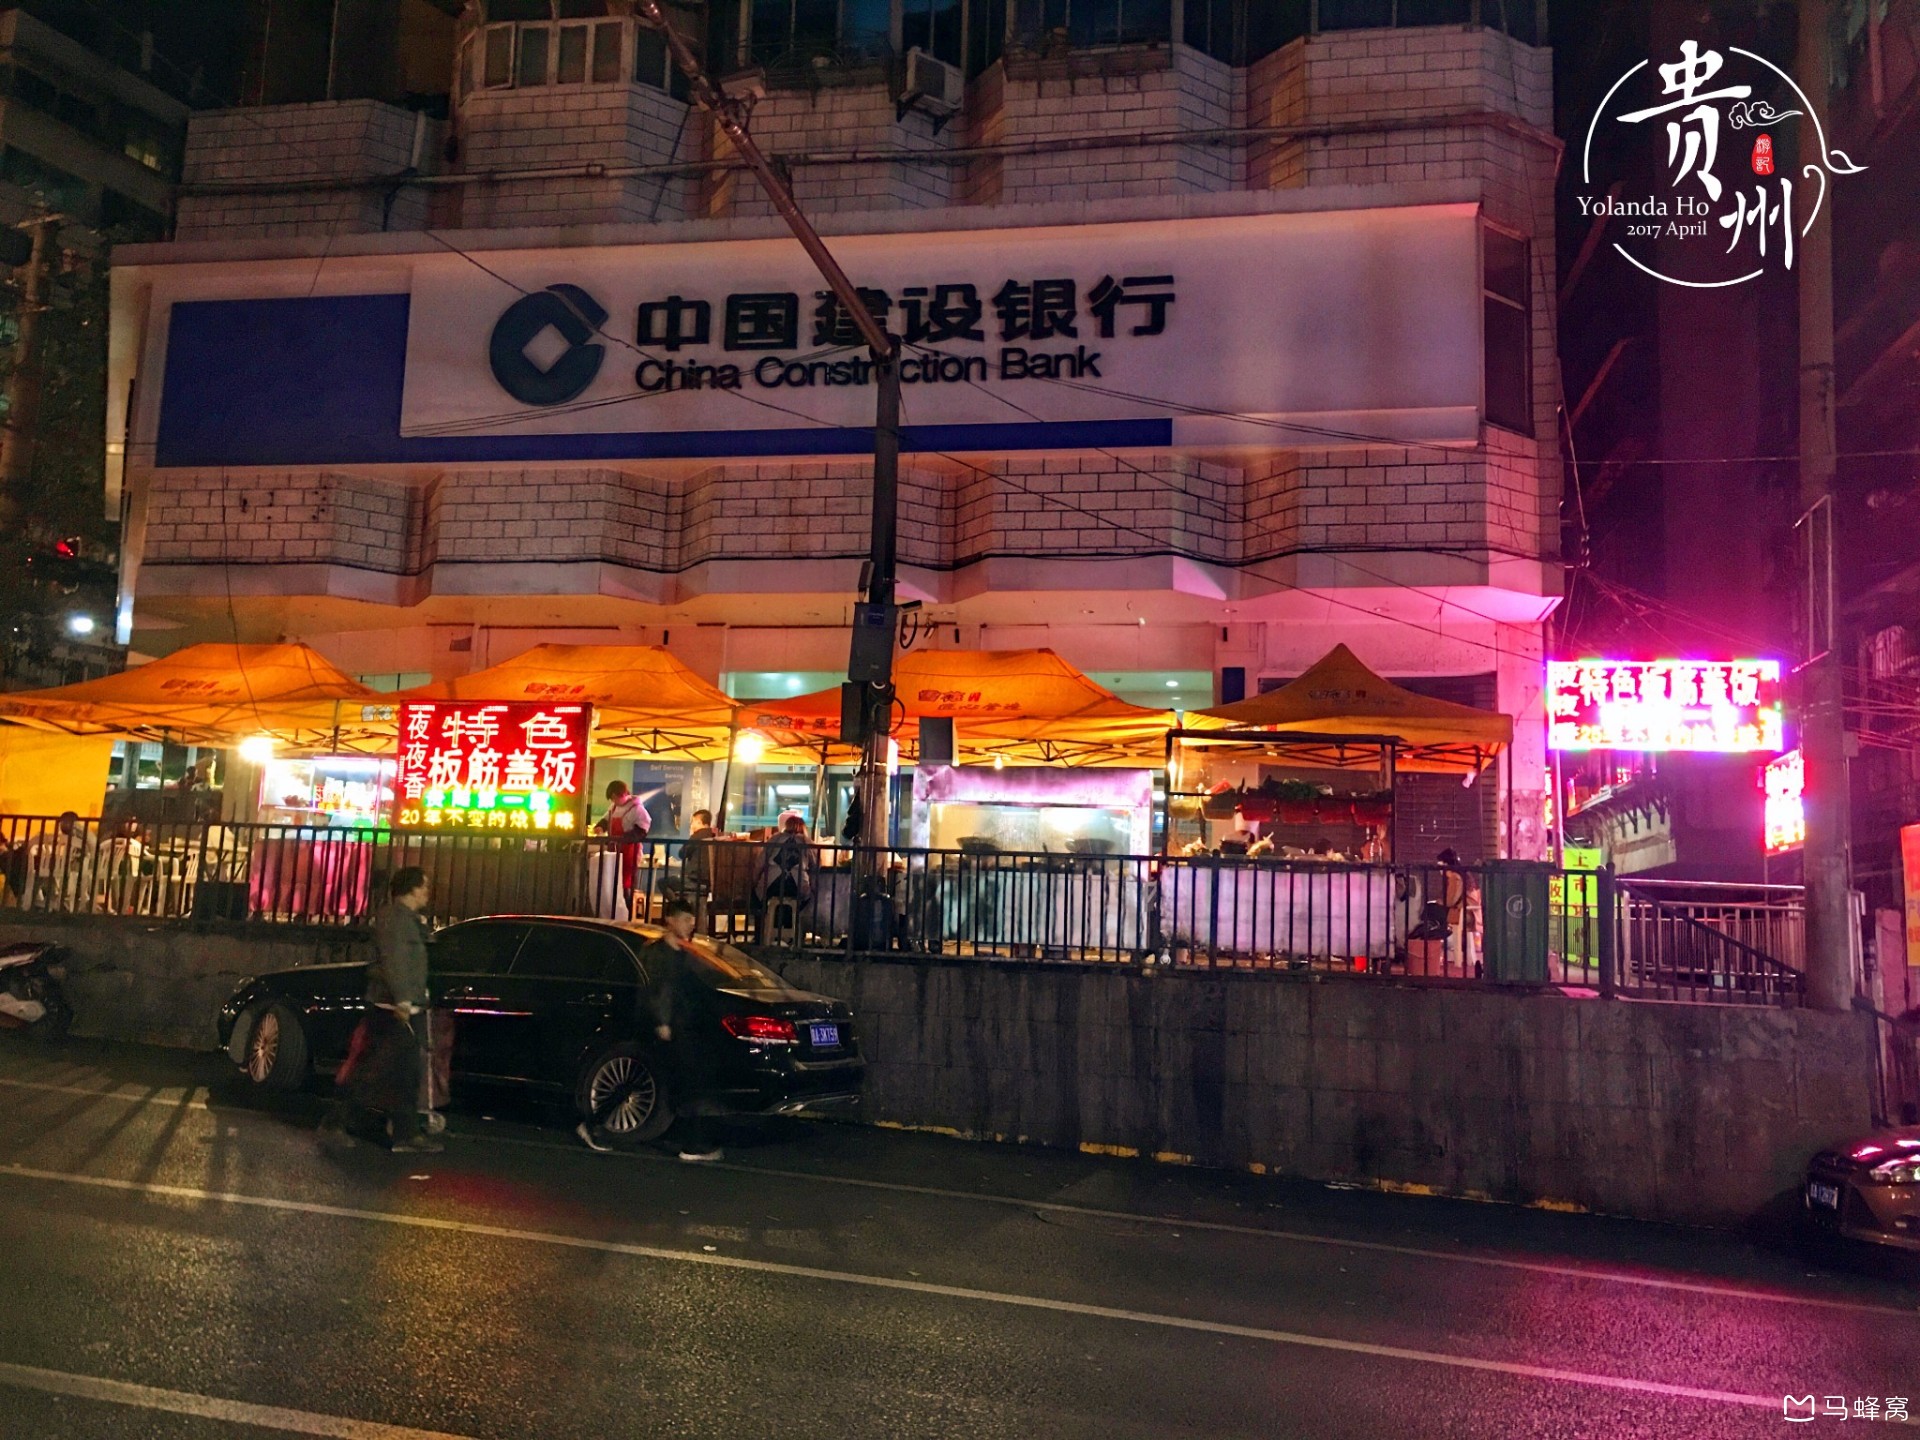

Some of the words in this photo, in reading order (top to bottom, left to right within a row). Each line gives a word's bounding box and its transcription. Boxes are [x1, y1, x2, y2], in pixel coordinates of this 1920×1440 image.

[634, 274, 1175, 352] 中国建设银行
[634, 357, 742, 390] China
[754, 350, 987, 387] Constrction
[1000, 346, 1101, 380] Bank
[441, 711, 573, 749] 特色
[404, 711, 431, 799] 夜夜香
[427, 747, 577, 794] 板筋盖饭
